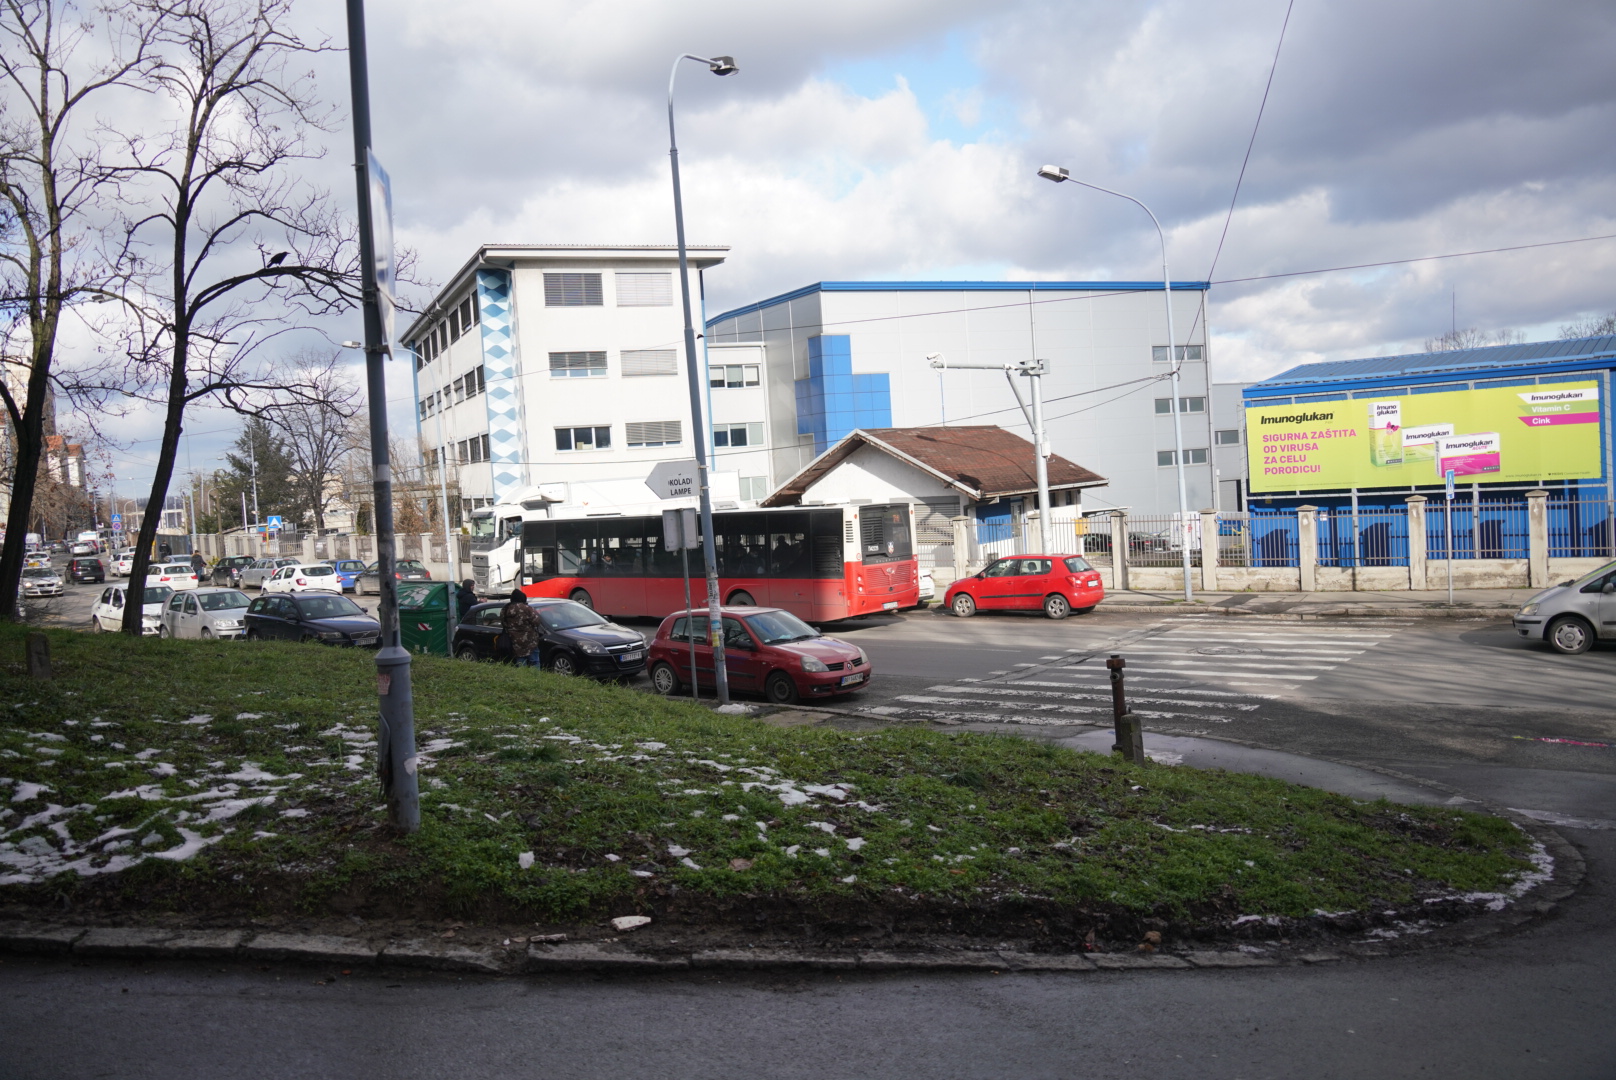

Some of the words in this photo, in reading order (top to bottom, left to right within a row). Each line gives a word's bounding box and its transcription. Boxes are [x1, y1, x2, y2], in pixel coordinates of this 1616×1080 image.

[1531, 392, 1583, 401] Imunoglukan
[1531, 405, 1562, 413] Vitamin
[1261, 412, 1333, 424] Imunoglukan
[1532, 417, 1551, 425] Cink
[1262, 432, 1308, 442] SIGURNA
[1310, 428, 1357, 439] ZAŠTITA
[1405, 430, 1450, 440] Imunoglukan
[1263, 445, 1278, 453] OD
[1280, 442, 1319, 452] VIRUSA
[1445, 439, 1493, 449] Imunoglukan
[1263, 456, 1278, 464] ZA
[1280, 454, 1307, 463] CELU
[1264, 465, 1321, 475] PORODICU!
[670, 487, 692, 496] LAMPE
